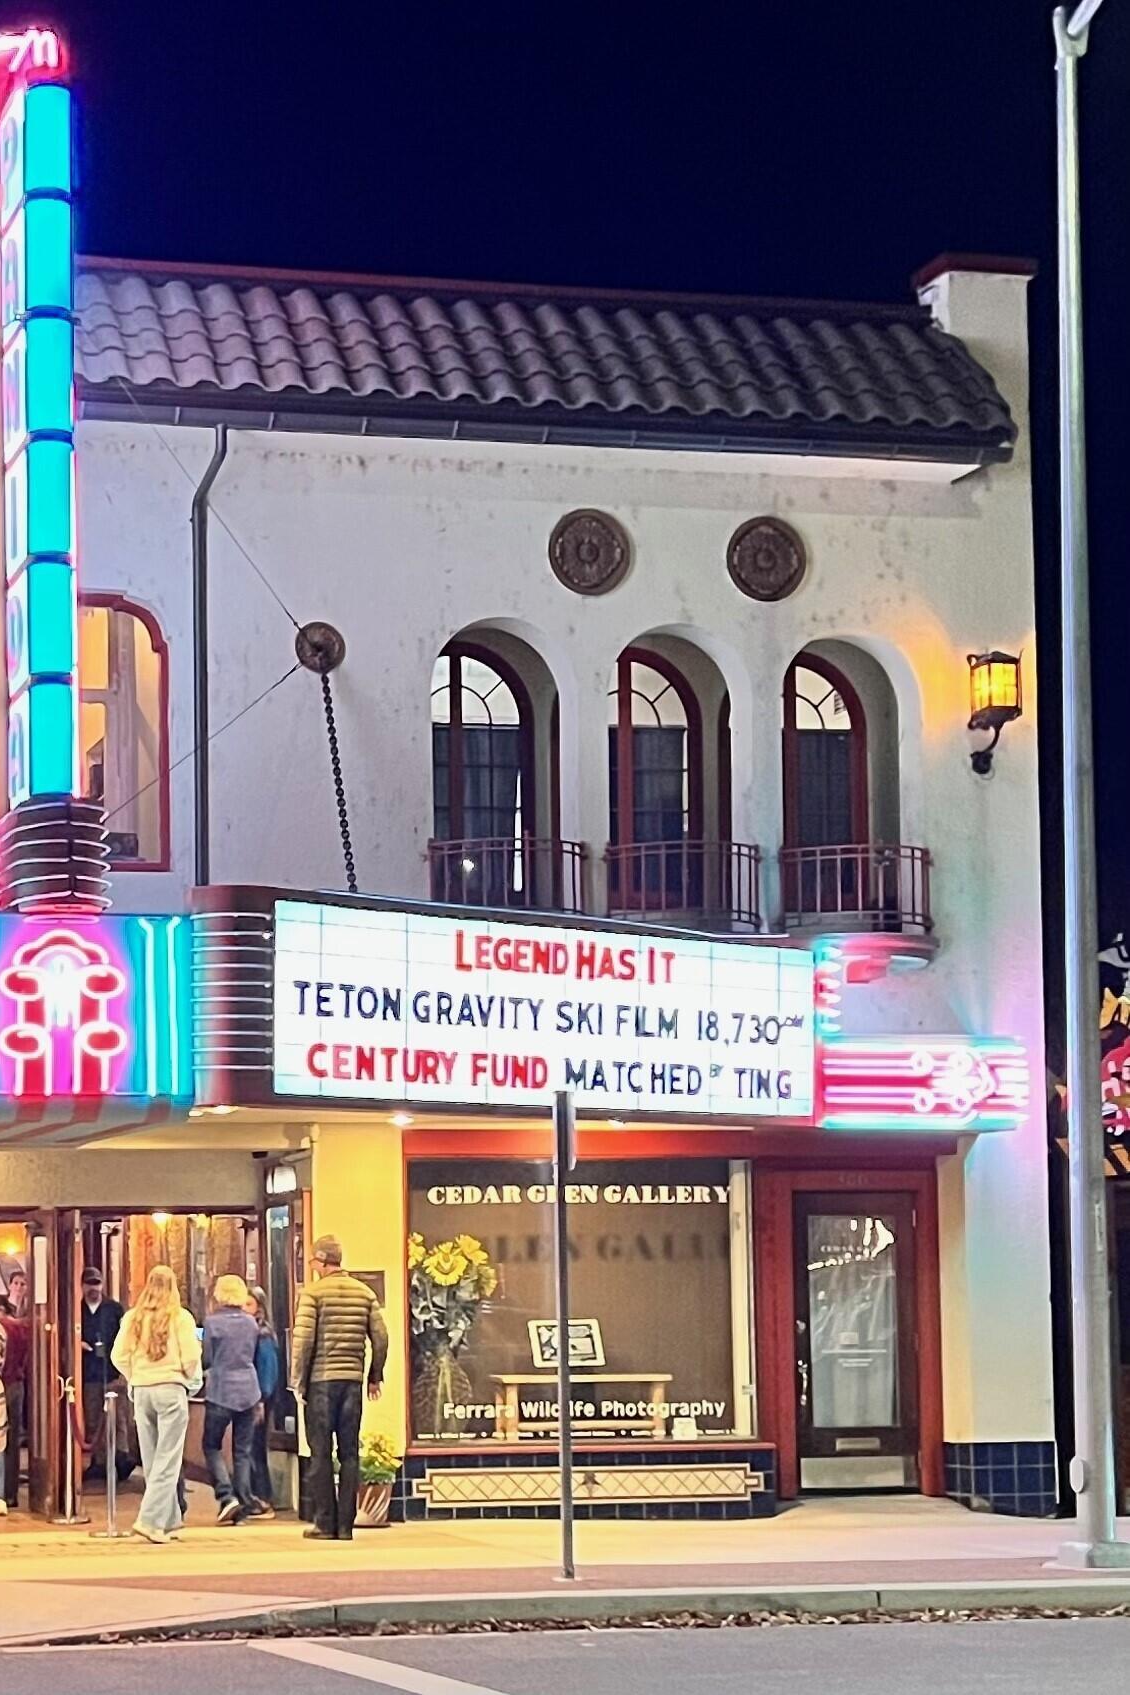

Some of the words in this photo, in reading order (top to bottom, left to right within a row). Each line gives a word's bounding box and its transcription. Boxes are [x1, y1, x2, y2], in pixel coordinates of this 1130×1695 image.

[455, 930, 568, 976] LEGEND
[575, 940, 636, 981] HAS
[647, 946, 676, 985] IT
[293, 980, 401, 1021] TETON
[412, 988, 544, 1032] GRAVITY
[556, 1001, 603, 1036] SKI
[616, 1005, 678, 1039] FILM
[306, 1042, 458, 1085] CENTURY
[471, 1053, 549, 1089] FUND
[565, 1057, 702, 1096] MATCHED
[734, 1068, 792, 1099] TING
[427, 1185, 522, 1205] CEDAR
[603, 1184, 730, 1205] GALLERY
[443, 1402, 516, 1419] Ferrara
[601, 1400, 726, 1420] Photography
